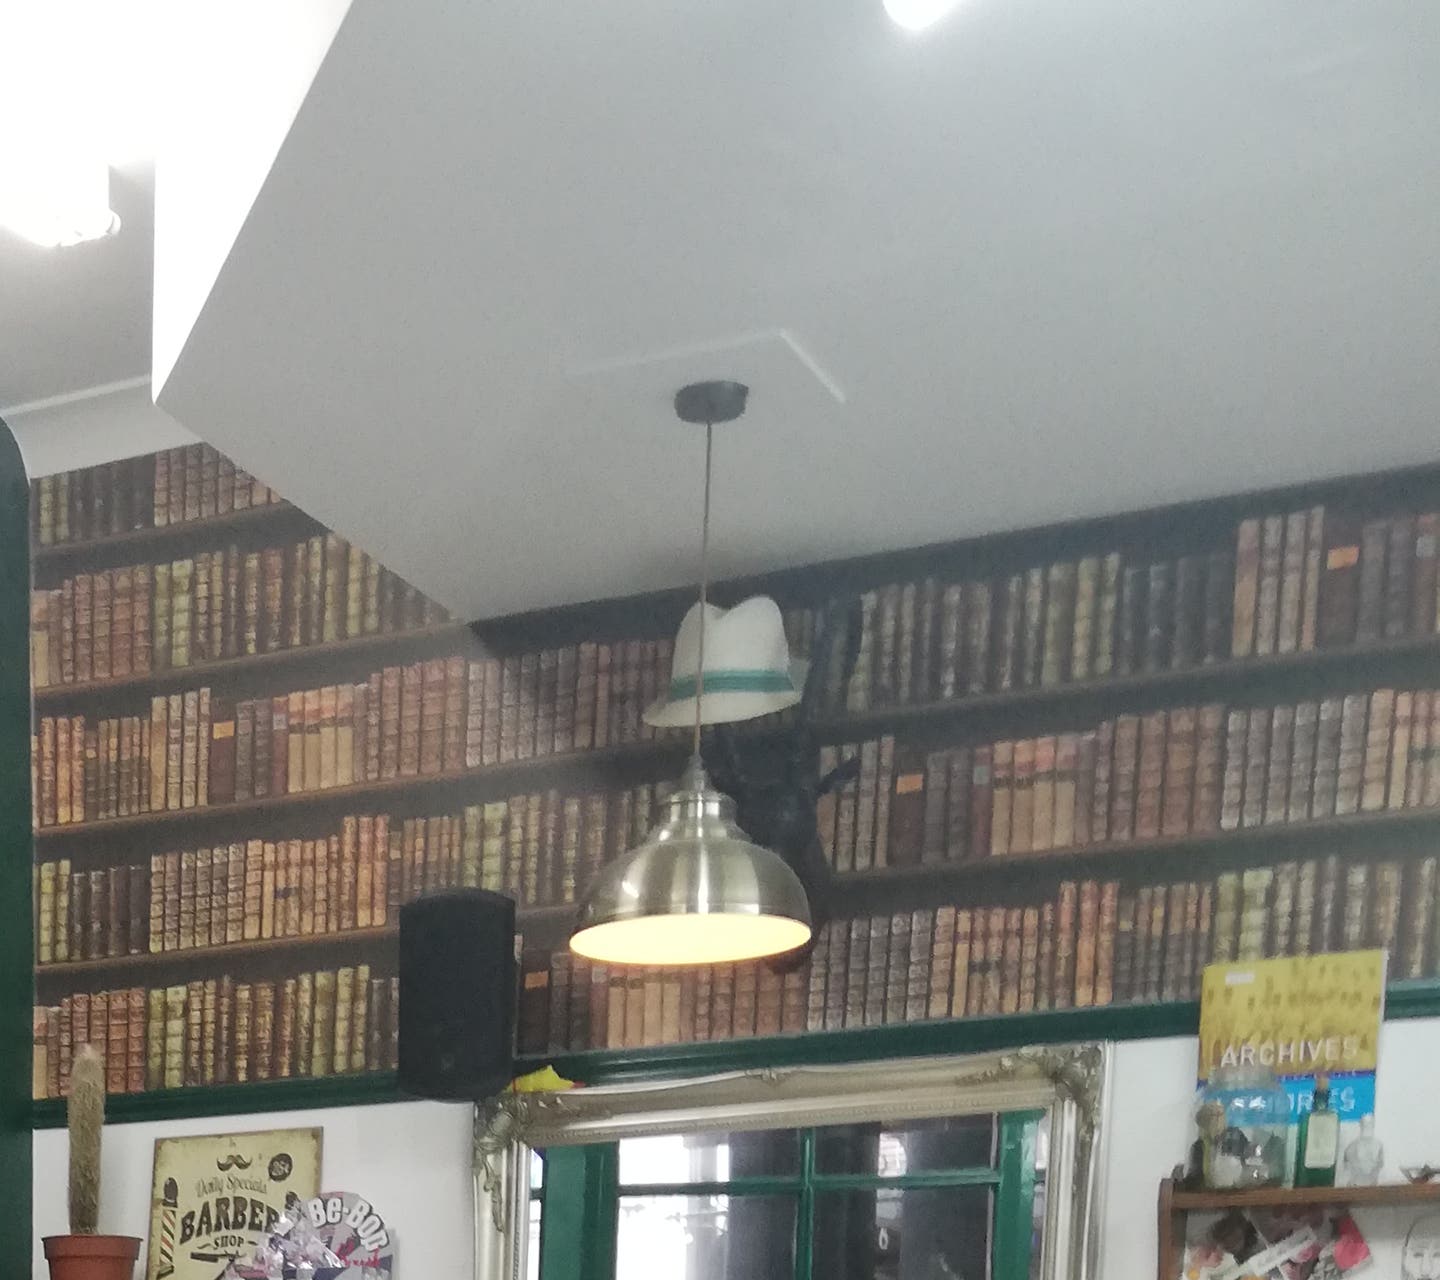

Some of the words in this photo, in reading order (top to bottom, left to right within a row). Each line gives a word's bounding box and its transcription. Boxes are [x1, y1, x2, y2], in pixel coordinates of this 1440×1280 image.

[1220, 1035, 1358, 1068] ARCHIVES
[179, 1196, 281, 1245] BARBER
[214, 1235, 245, 1248] SHOP
